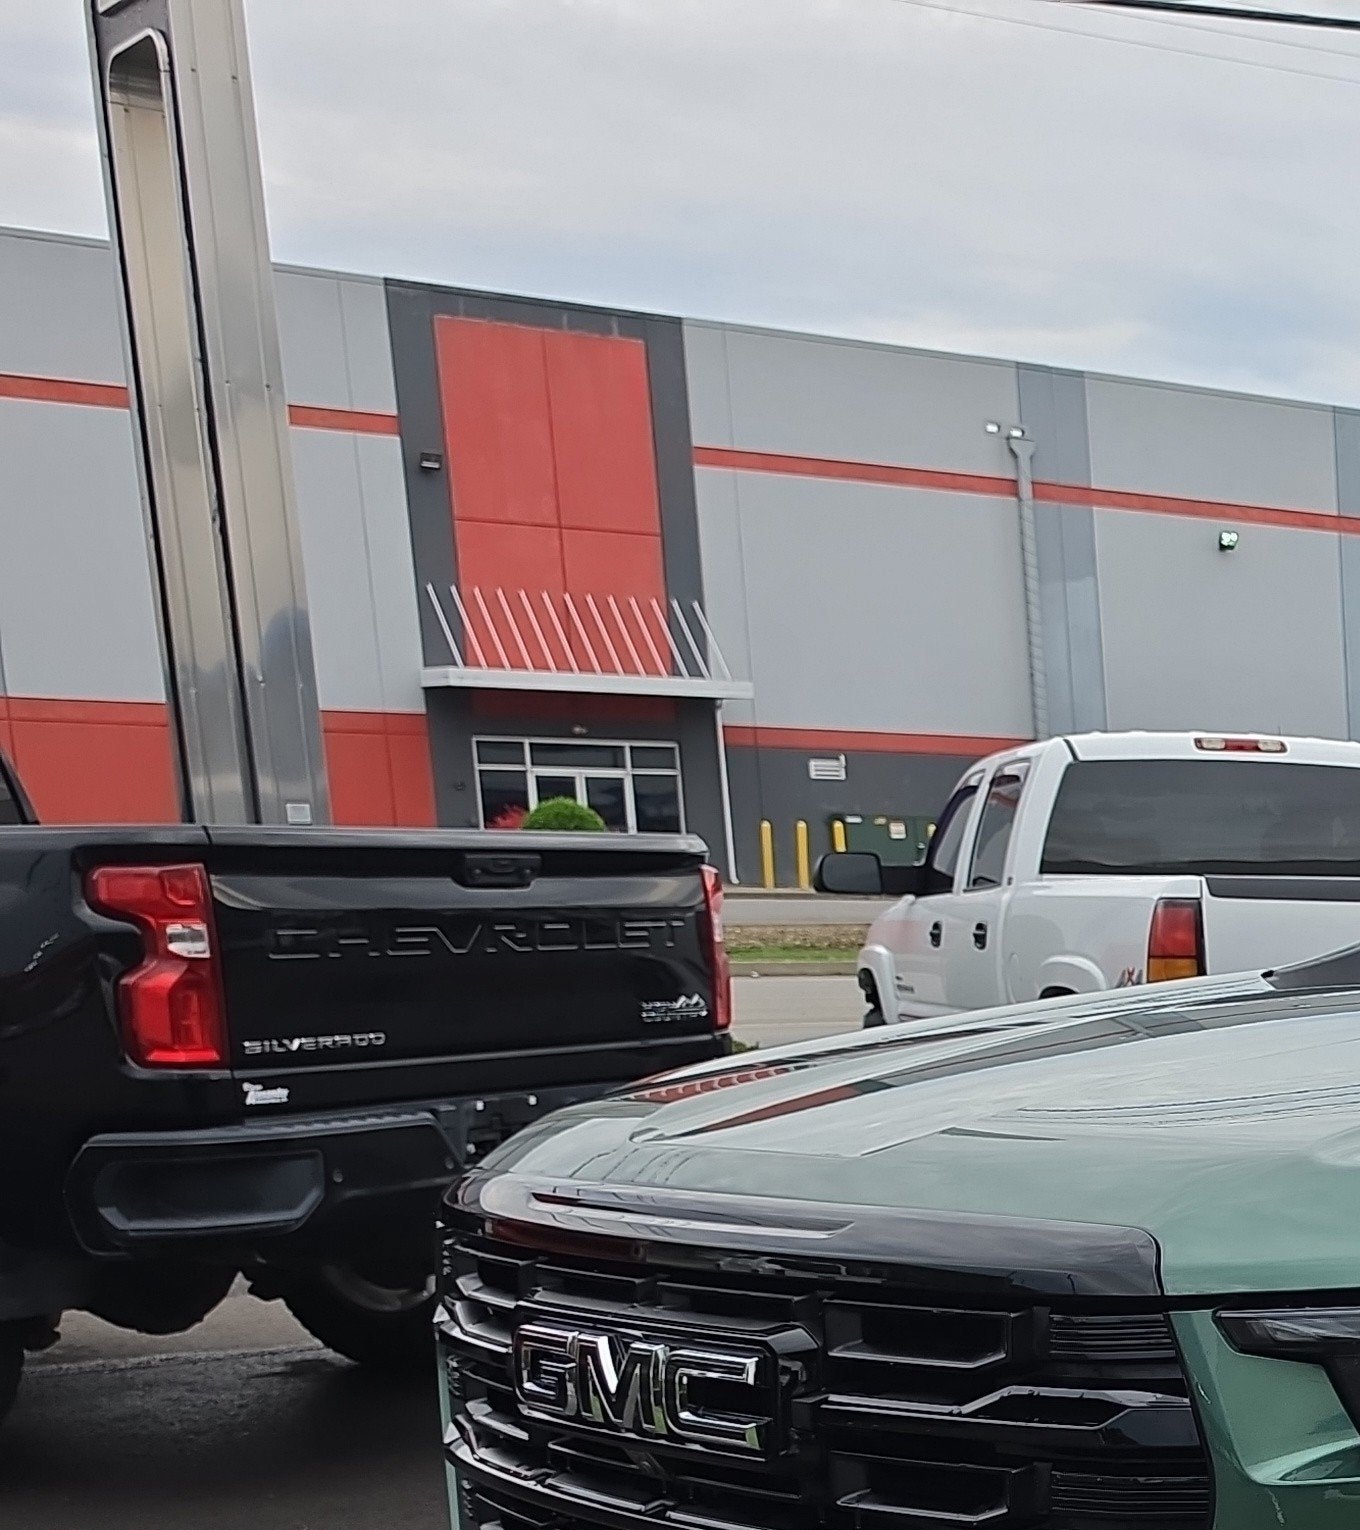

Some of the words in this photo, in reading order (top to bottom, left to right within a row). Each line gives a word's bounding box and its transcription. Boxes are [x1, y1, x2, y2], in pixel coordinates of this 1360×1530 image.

[268, 917, 685, 960] CHEVROLET
[242, 1031, 387, 1055] SILVERADO
[513, 1322, 774, 1460] GMC
